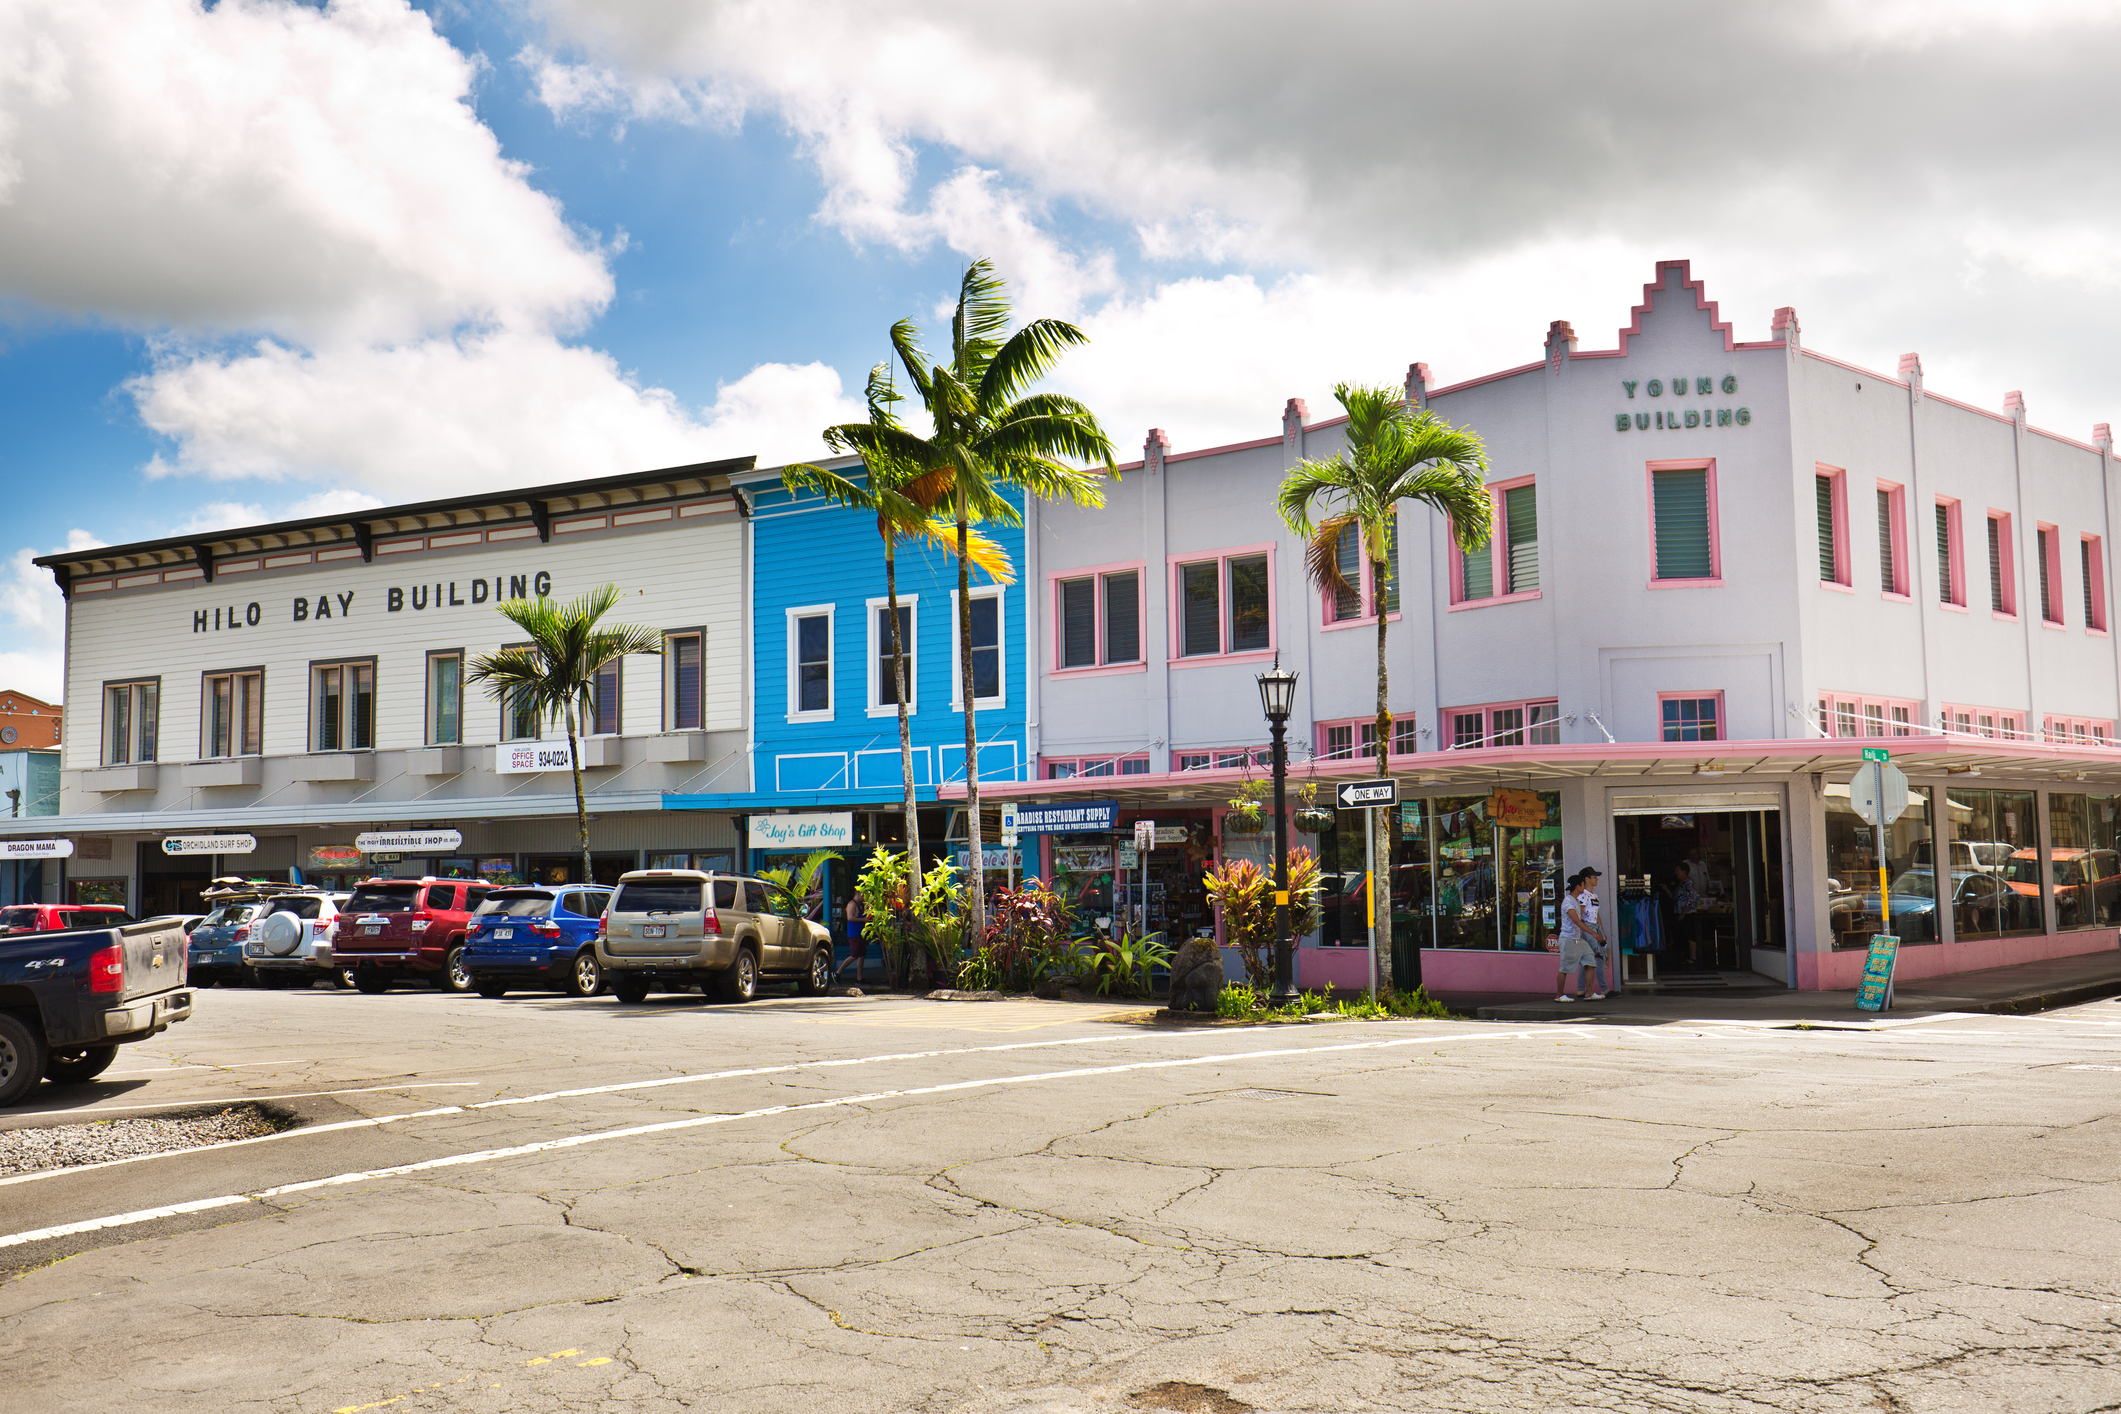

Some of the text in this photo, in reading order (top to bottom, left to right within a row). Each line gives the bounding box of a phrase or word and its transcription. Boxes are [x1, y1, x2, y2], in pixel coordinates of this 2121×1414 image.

[1622, 375, 1738, 398] YOUNG
[1615, 407, 1752, 431] BUILDING
[193, 571, 551, 633] HILO BAY BUILDING
[512, 752, 534, 760] OFFICE
[539, 750, 568, 767] 934-0224
[512, 760, 534, 768] SPACE
[1354, 788, 1390, 800] ONE WAY
[1016, 807, 1111, 825] ARADISE RESTAURANT SUPPLY
[1071, 822, 1099, 830] PROFESSIONAL
[766, 823, 846, 842] Joy's Gift Shop
[7, 843, 35, 852] DRAGON
[183, 840, 219, 850] ORCHIDLAND
[220, 840, 235, 848] SURF
[236, 839, 253, 848] SHOP
[379, 837, 422, 846] IRRESISTIBLE
[424, 837, 443, 845] SHOP
[1001, 852, 1022, 866] Sle
[1201, 860, 1214, 868] OPE
